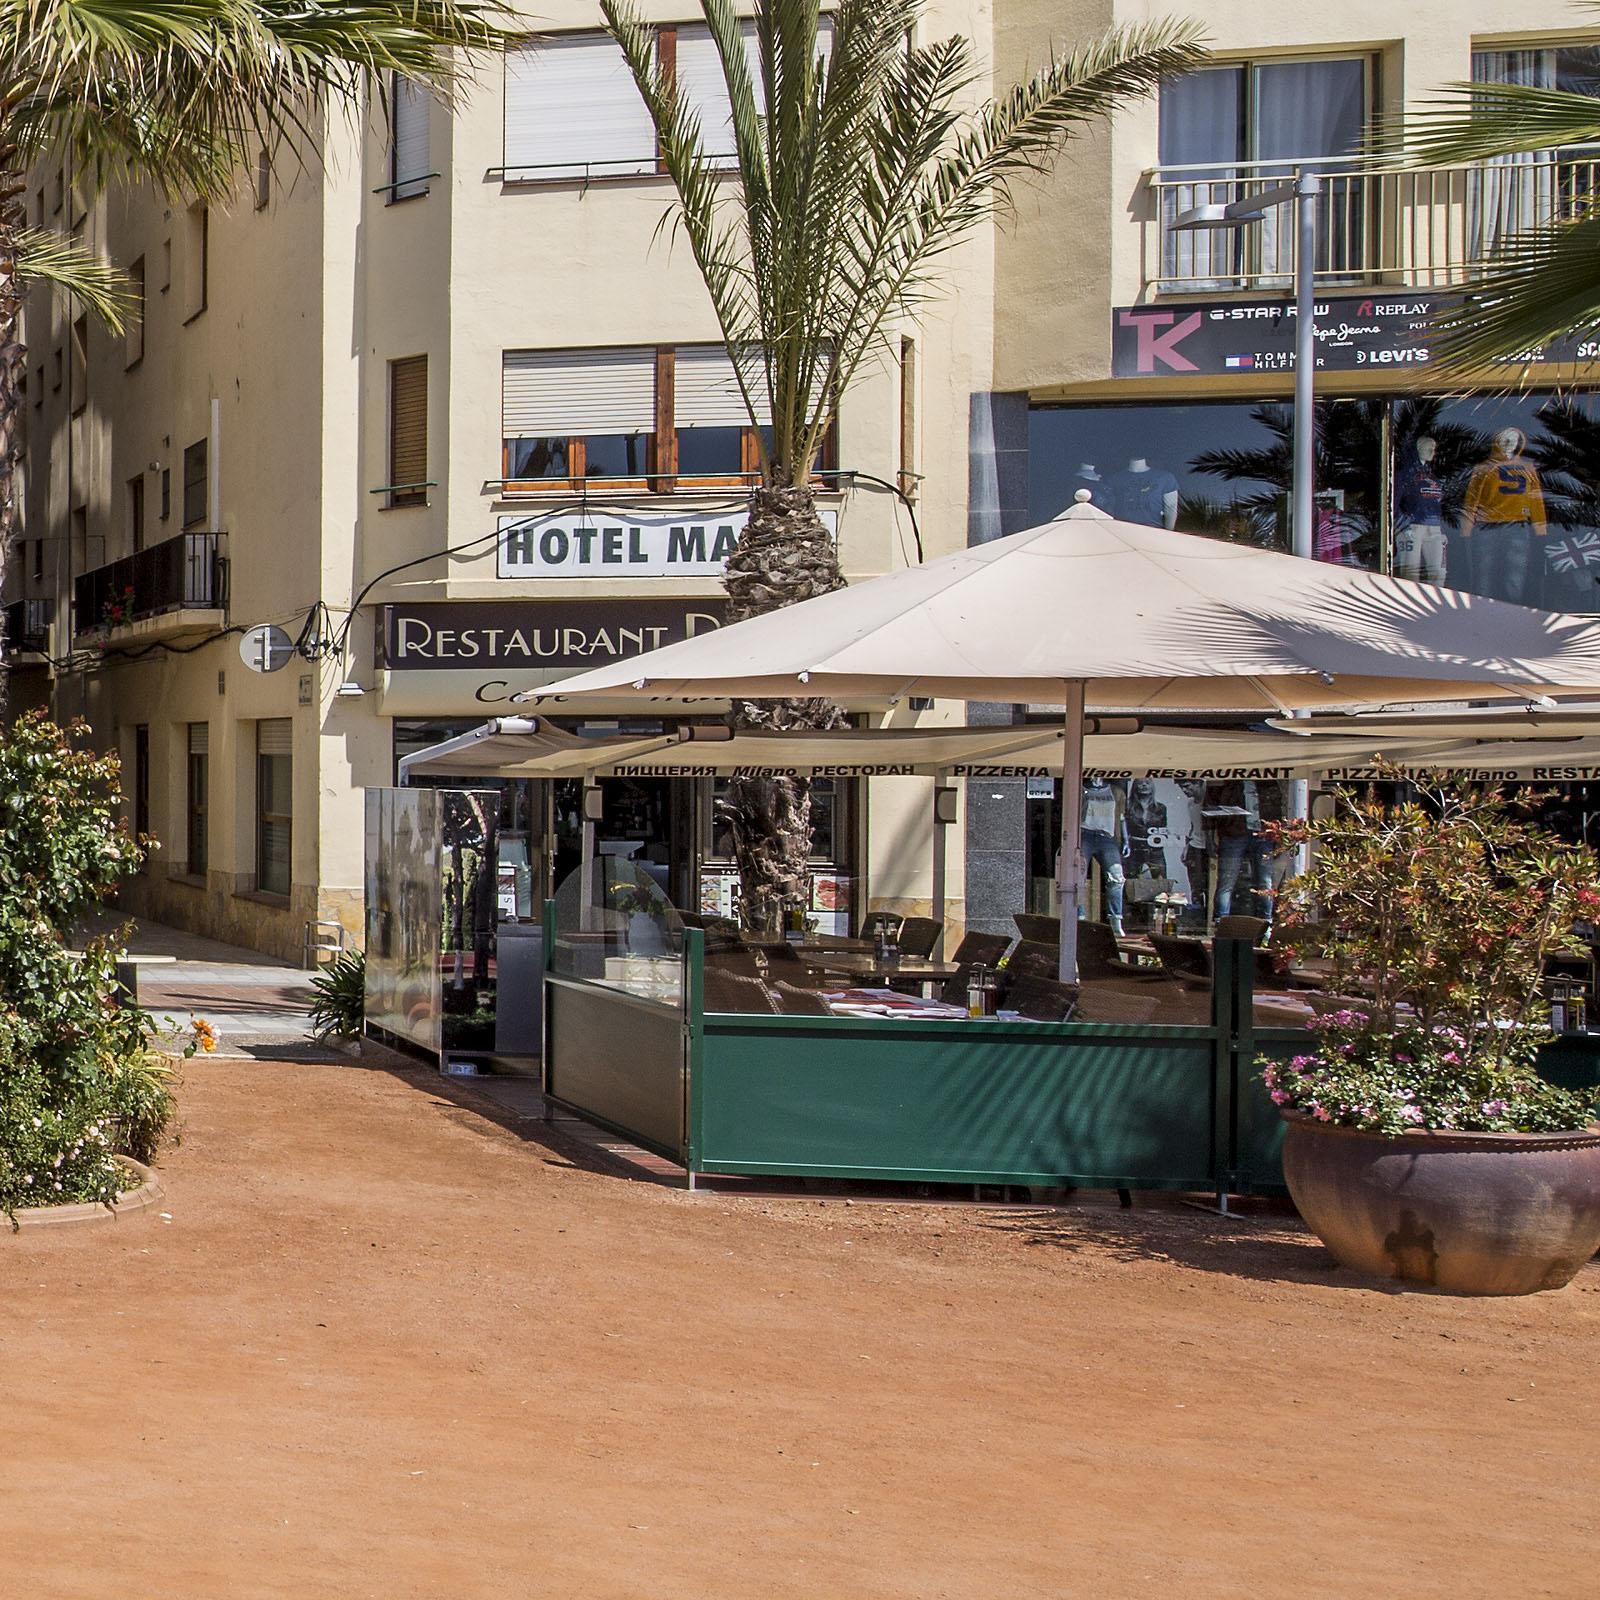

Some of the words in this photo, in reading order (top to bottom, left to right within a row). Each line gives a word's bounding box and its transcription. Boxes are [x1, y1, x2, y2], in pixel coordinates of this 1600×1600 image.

[1209, 307, 1282, 320] G-STAR
[1286, 304, 1330, 318] RW
[1375, 302, 1430, 316] REPLAY
[1337, 322, 1382, 341] Jeans
[1254, 351, 1298, 361] TOMM
[1254, 357, 1325, 369] HILFIR
[1497, 464, 1528, 495] 5
[506, 527, 649, 565] HOTEL
[613, 765, 718, 777] ПИЦЦЕРИЯ
[732, 766, 798, 777] Milano
[811, 764, 915, 777] РЕСТОРАН
[953, 765, 1050, 778] PIZZERIA
[1081, 767, 1133, 779] ilano
[1145, 767, 1295, 779] RESTAURANT
[1327, 767, 1430, 780] PIZZEIA
